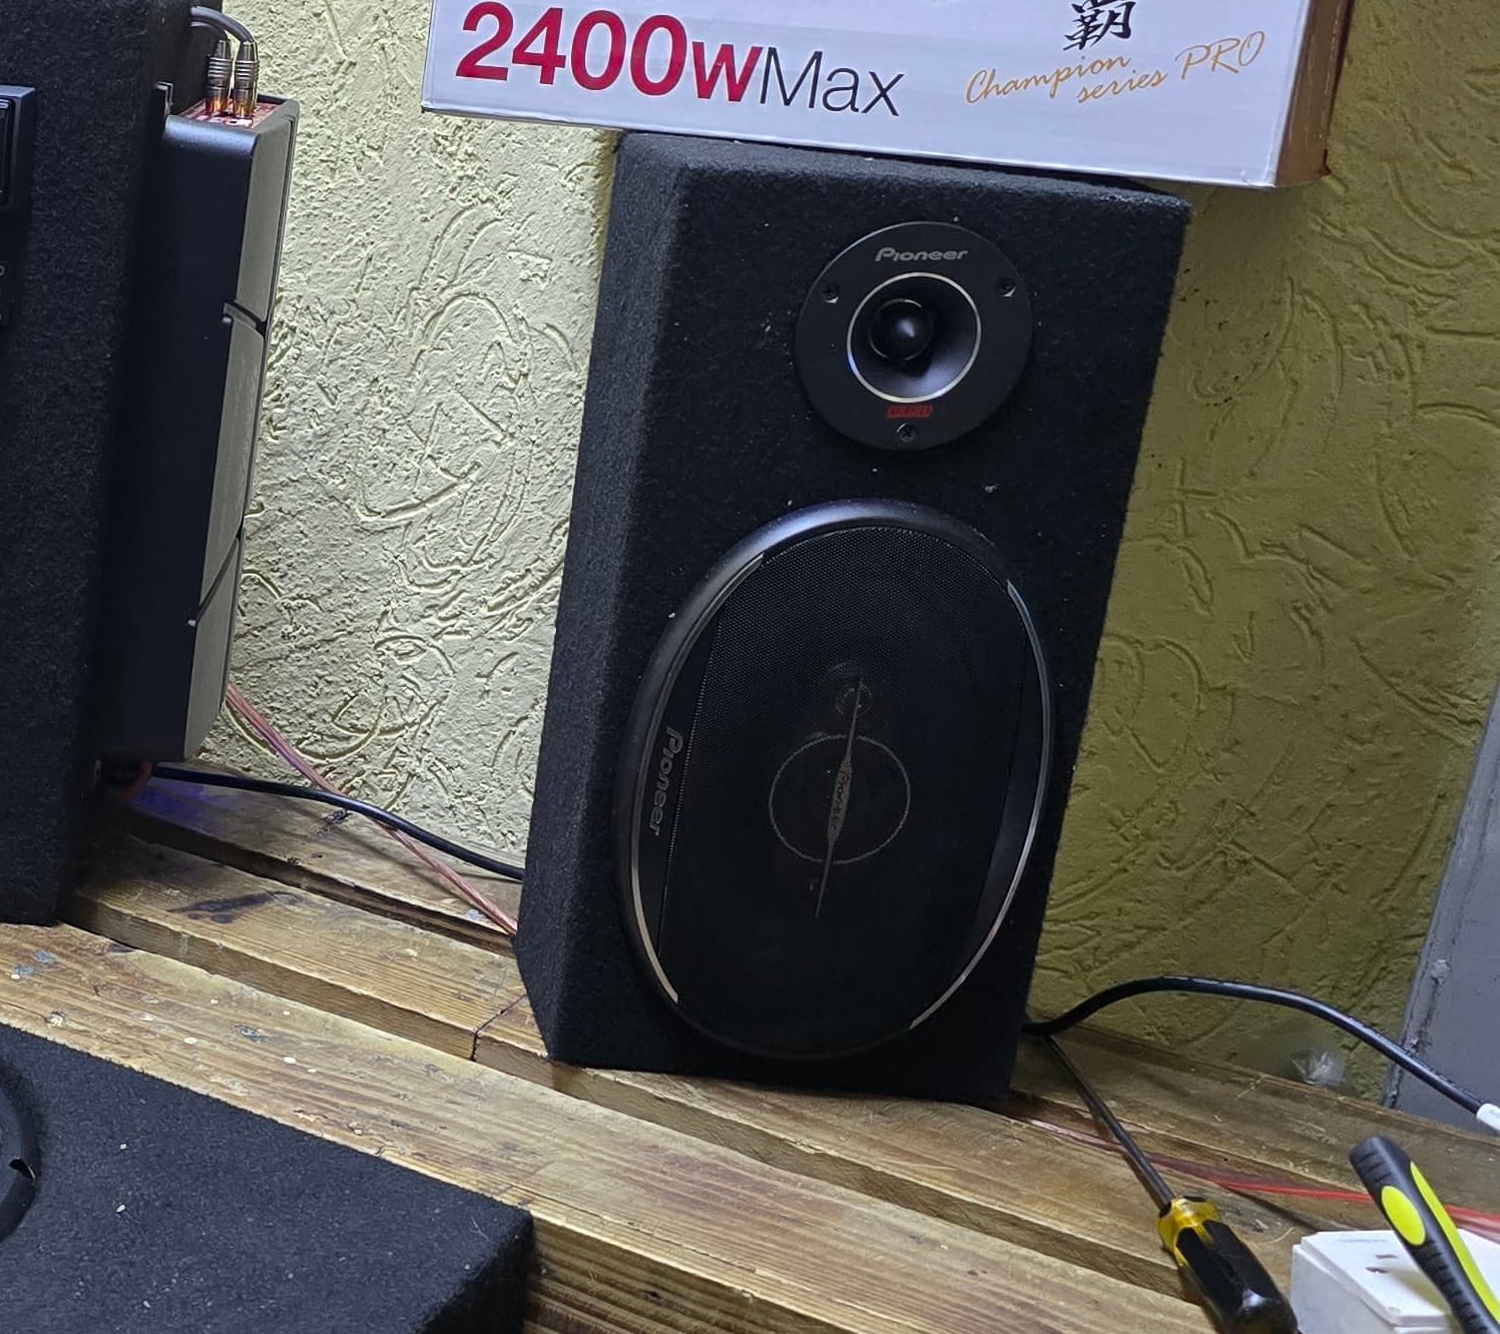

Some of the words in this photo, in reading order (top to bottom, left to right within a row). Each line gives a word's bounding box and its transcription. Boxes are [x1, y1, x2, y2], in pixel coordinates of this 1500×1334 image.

[964, 54, 1132, 104] Champion
[1076, 69, 1168, 104] series
[1175, 31, 1265, 80] PRO
[875, 247, 968, 262] Pioneer
[649, 726, 684, 836] Pioneer
